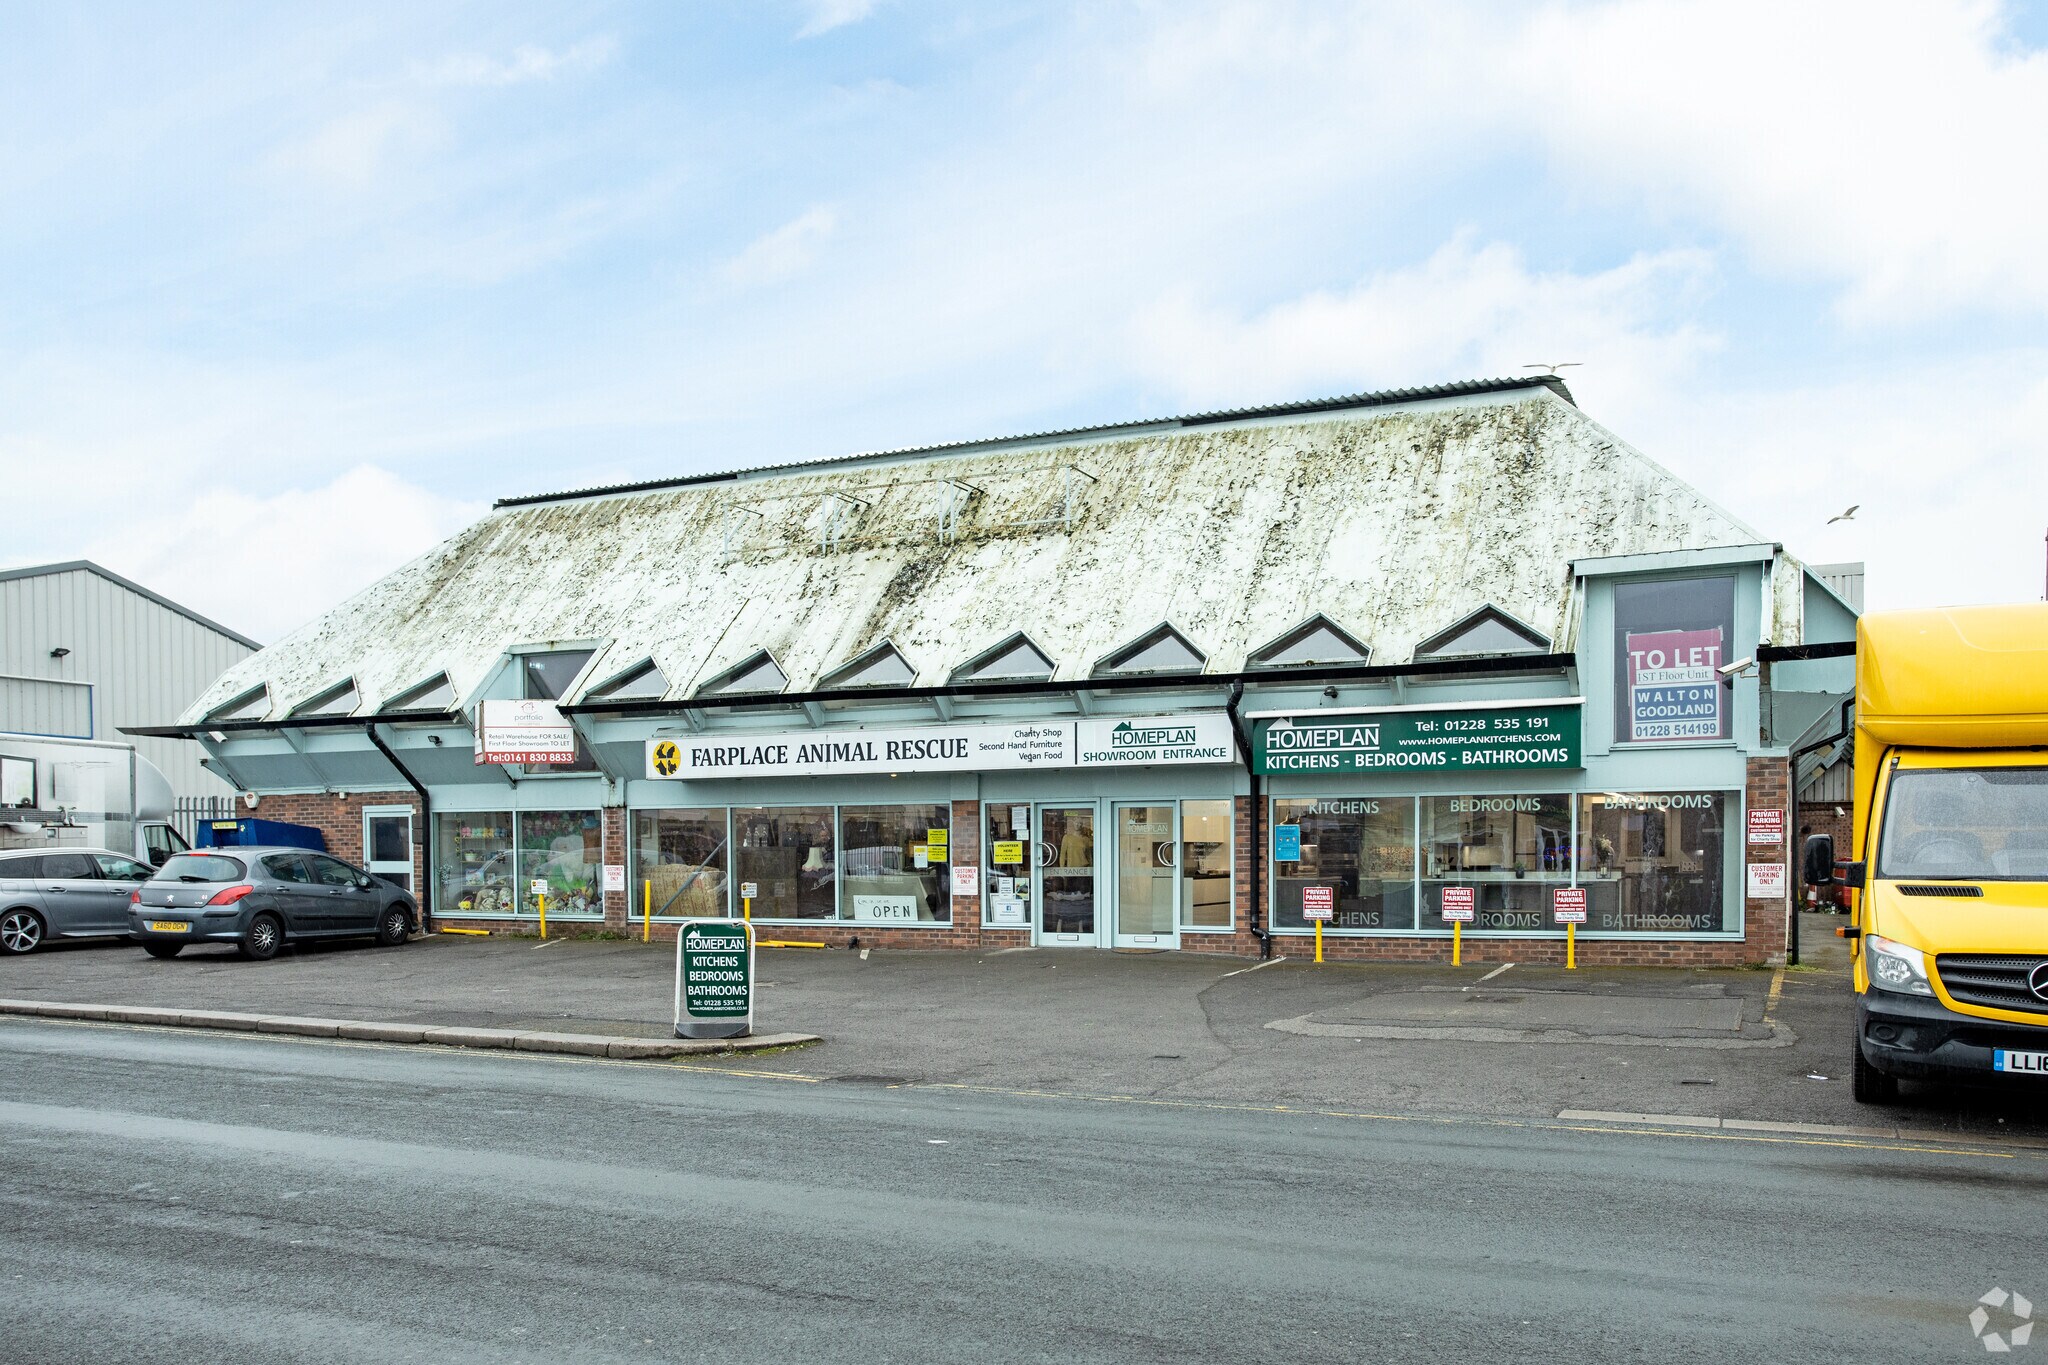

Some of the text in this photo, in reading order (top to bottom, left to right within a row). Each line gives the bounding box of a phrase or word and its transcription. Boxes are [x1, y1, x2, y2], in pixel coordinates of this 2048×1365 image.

[1631, 646, 1719, 669] TO LET
[1638, 670, 1708, 681] 1ST Floor Unit
[1637, 689, 1713, 702] WALTON
[1637, 703, 1714, 717] GOODLAND
[1415, 717, 1549, 731] Tel: 01228 535 191
[1635, 723, 1716, 737] 01228 514199
[1014, 729, 1062, 739] Charity Shop
[1112, 730, 1196, 744] HOMEPLAN
[1266, 728, 1379, 748] HOMEPLAN
[1399, 733, 1561, 746] www.HOMEPLANKITCHENS.COM
[979, 740, 1062, 750] Second Hand Furniture
[529, 753, 547, 761] 830
[549, 753, 572, 761] 8833
[691, 738, 969, 767] FARPLACE ANIMAL RESCUE
[1019, 751, 1062, 762] Vegan Food
[1083, 748, 1227, 761] SHOWROOM ENTRANCE
[1266, 754, 1339, 769] KITCHENS
[1355, 751, 1446, 766] BEDROOMS
[1462, 748, 1568, 764] BATHROOMS
[1308, 801, 1379, 814] KITCHENS
[1450, 798, 1541, 812] BEDROOMS
[1604, 794, 1712, 809] BATHROOMS
[873, 905, 911, 918] OPEN
[1308, 912, 1379, 926] CHENS
[1450, 913, 1541, 927] DROOMS
[1602, 914, 1711, 928] BATHROOMS
[686, 939, 744, 949] HOMEPLAN
[693, 956, 738, 966] KITCHENS
[689, 971, 743, 981] BEDROOMS
[688, 986, 747, 995] BATHROOMS
